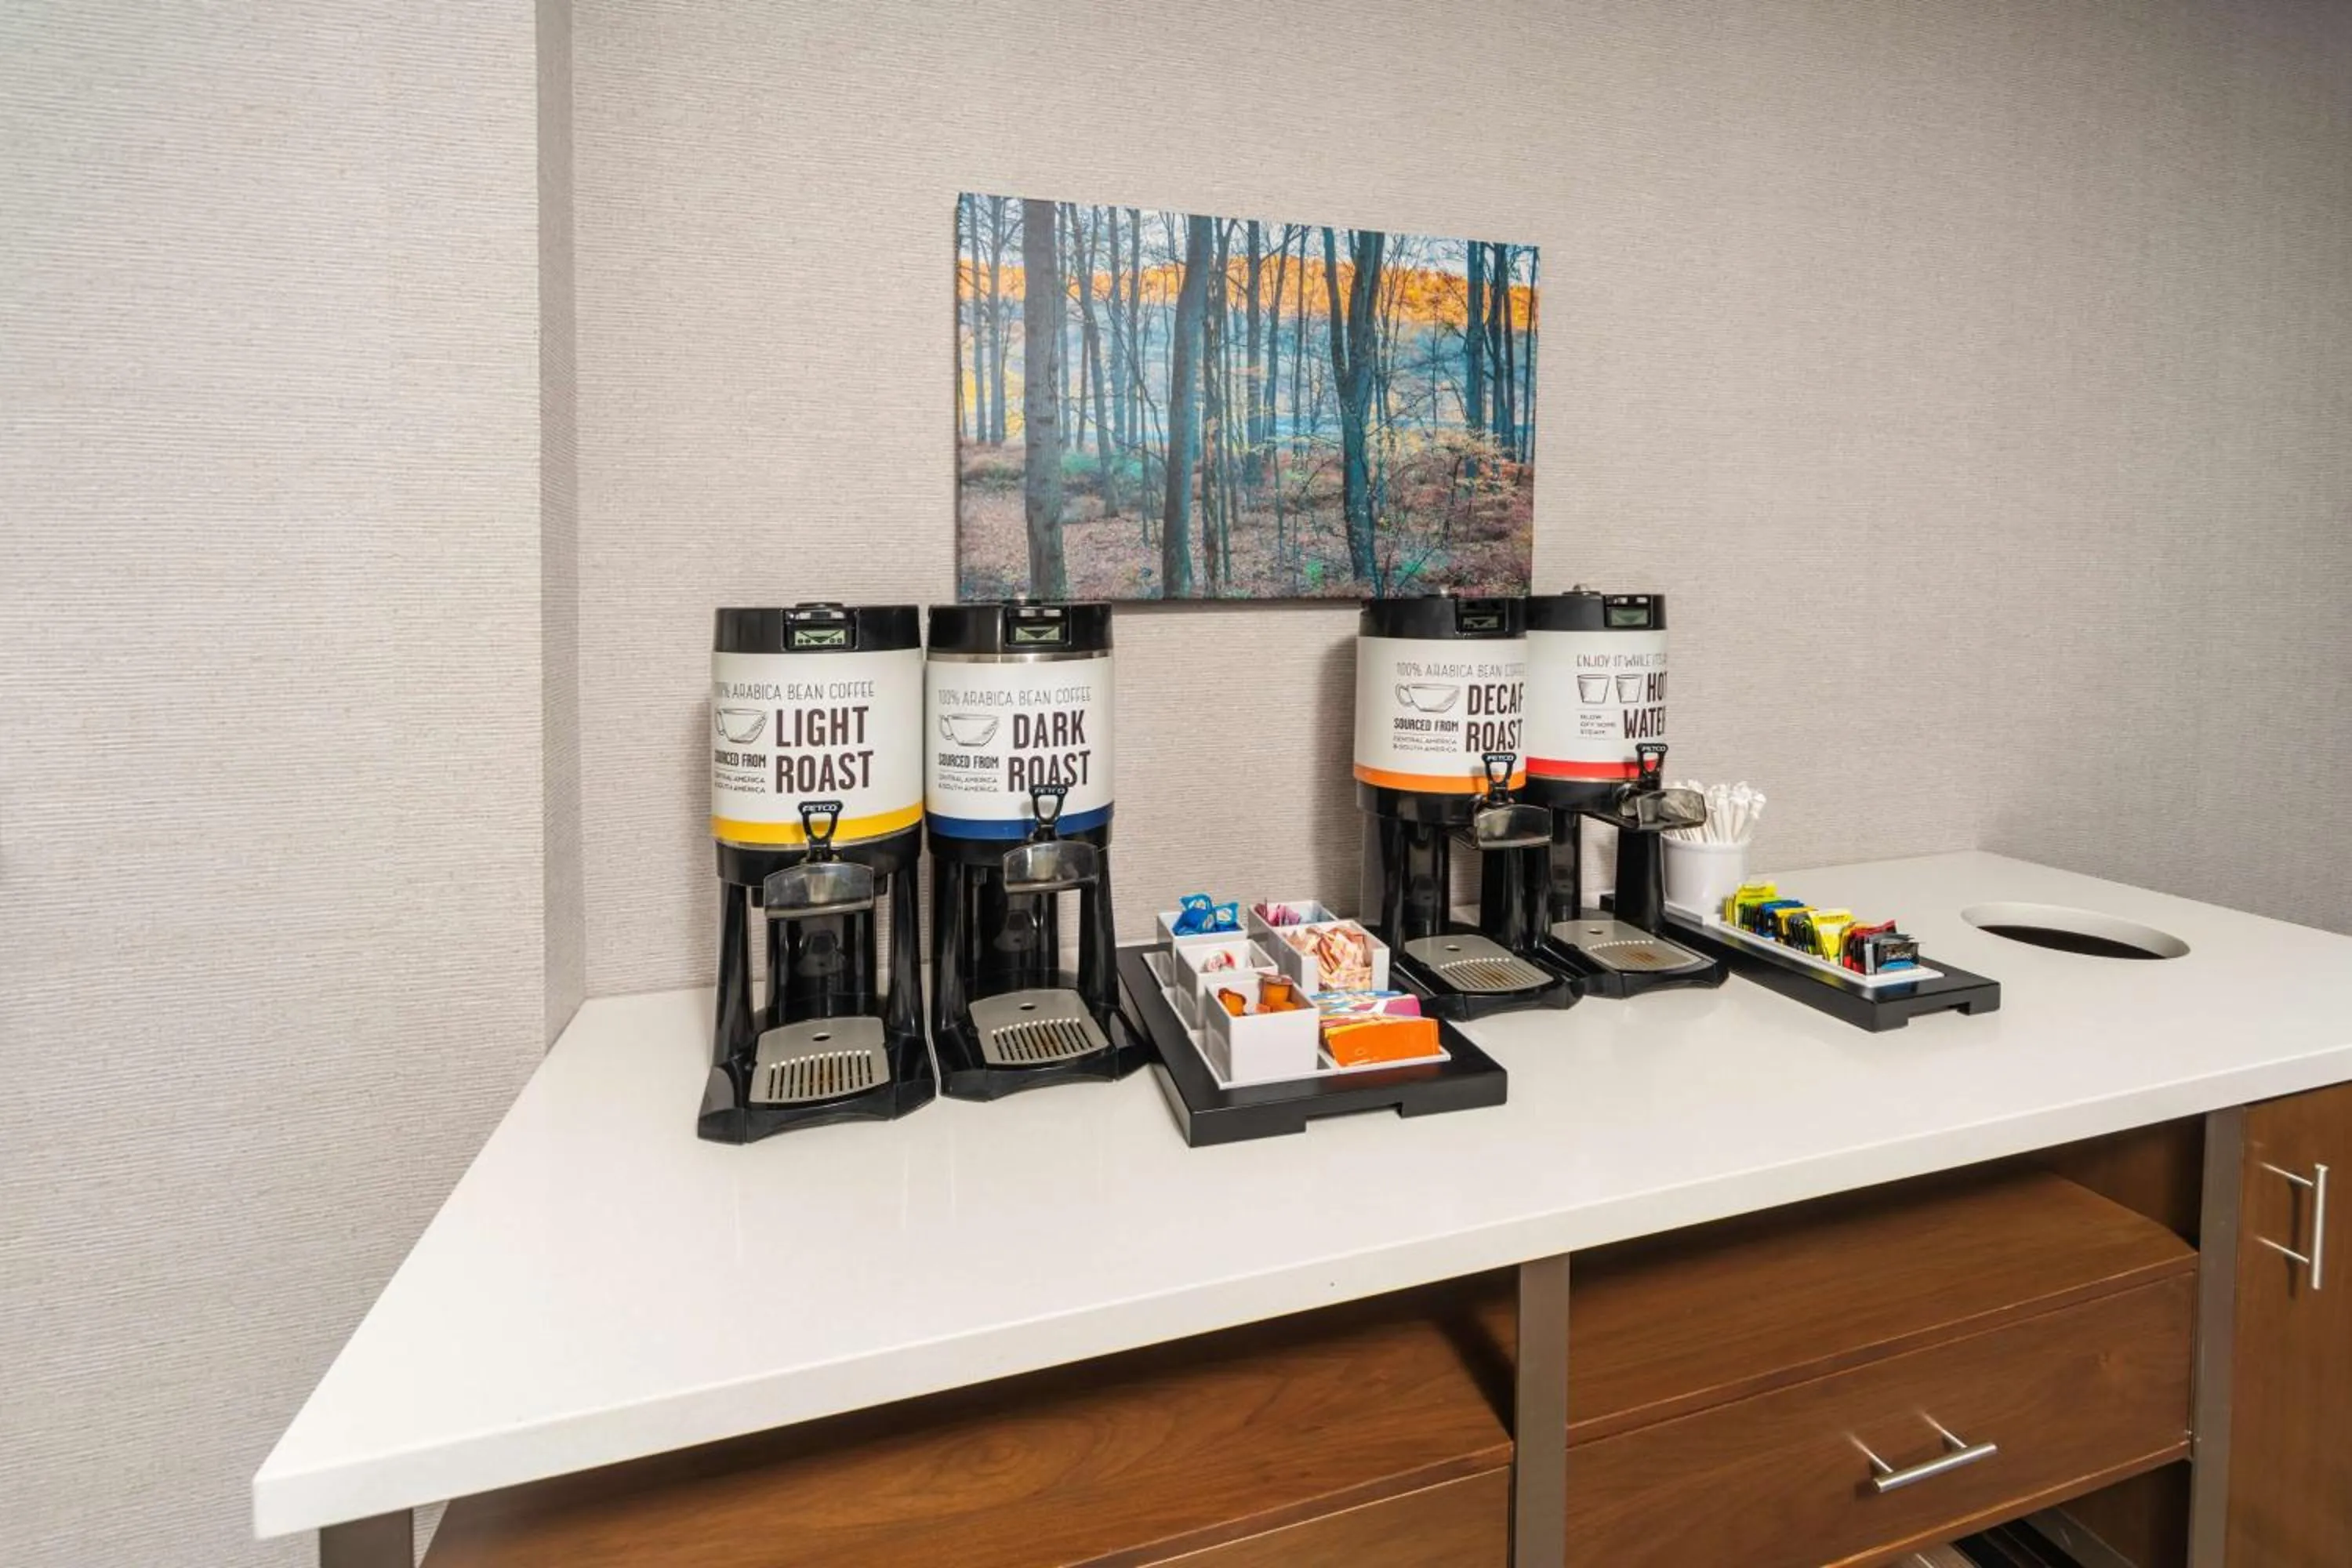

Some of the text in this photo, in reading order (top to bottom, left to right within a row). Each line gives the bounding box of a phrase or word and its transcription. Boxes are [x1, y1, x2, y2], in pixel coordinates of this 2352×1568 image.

[1425, 664, 1473, 678] ARABICA
[1477, 664, 1502, 678] BEAN
[731, 683, 782, 700] ARABICA
[787, 683, 824, 700] BEAN
[829, 681, 875, 699] COFFEE
[961, 689, 1014, 706] ARABICA
[1018, 689, 1051, 706] BEAN
[1055, 685, 1092, 704] COFFEE
[1467, 681, 1524, 716] DECAF
[775, 706, 869, 747] LIGHT
[1013, 709, 1086, 750] DARK
[1393, 717, 1459, 732] SOURCED FROM
[1465, 718, 1523, 753] ROAST
[742, 753, 767, 769] FROM
[775, 750, 874, 794] ROAST
[938, 752, 1000, 769] SOURCED FROM
[1007, 750, 1091, 793] ROAST
